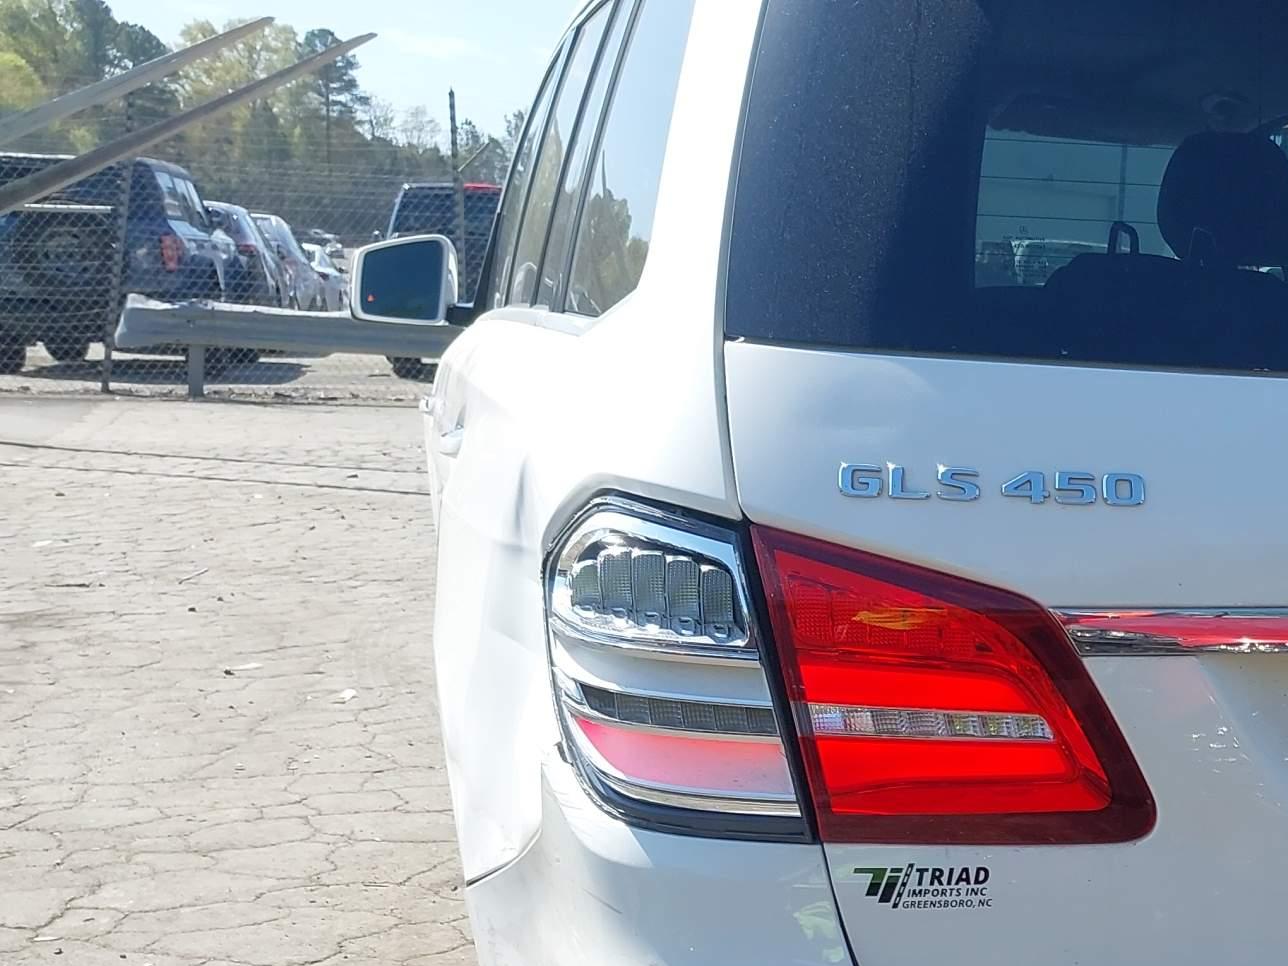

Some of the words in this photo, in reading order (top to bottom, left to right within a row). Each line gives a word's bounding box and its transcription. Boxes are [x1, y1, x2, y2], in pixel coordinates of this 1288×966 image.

[837, 461, 981, 501] GLS
[1000, 471, 1146, 506] 450
[915, 865, 990, 887] TRIAD
[907, 888, 962, 899] IMPORTS
[965, 887, 988, 897] INC
[902, 898, 976, 909] GREENSBORO,
[978, 897, 993, 908] NC
